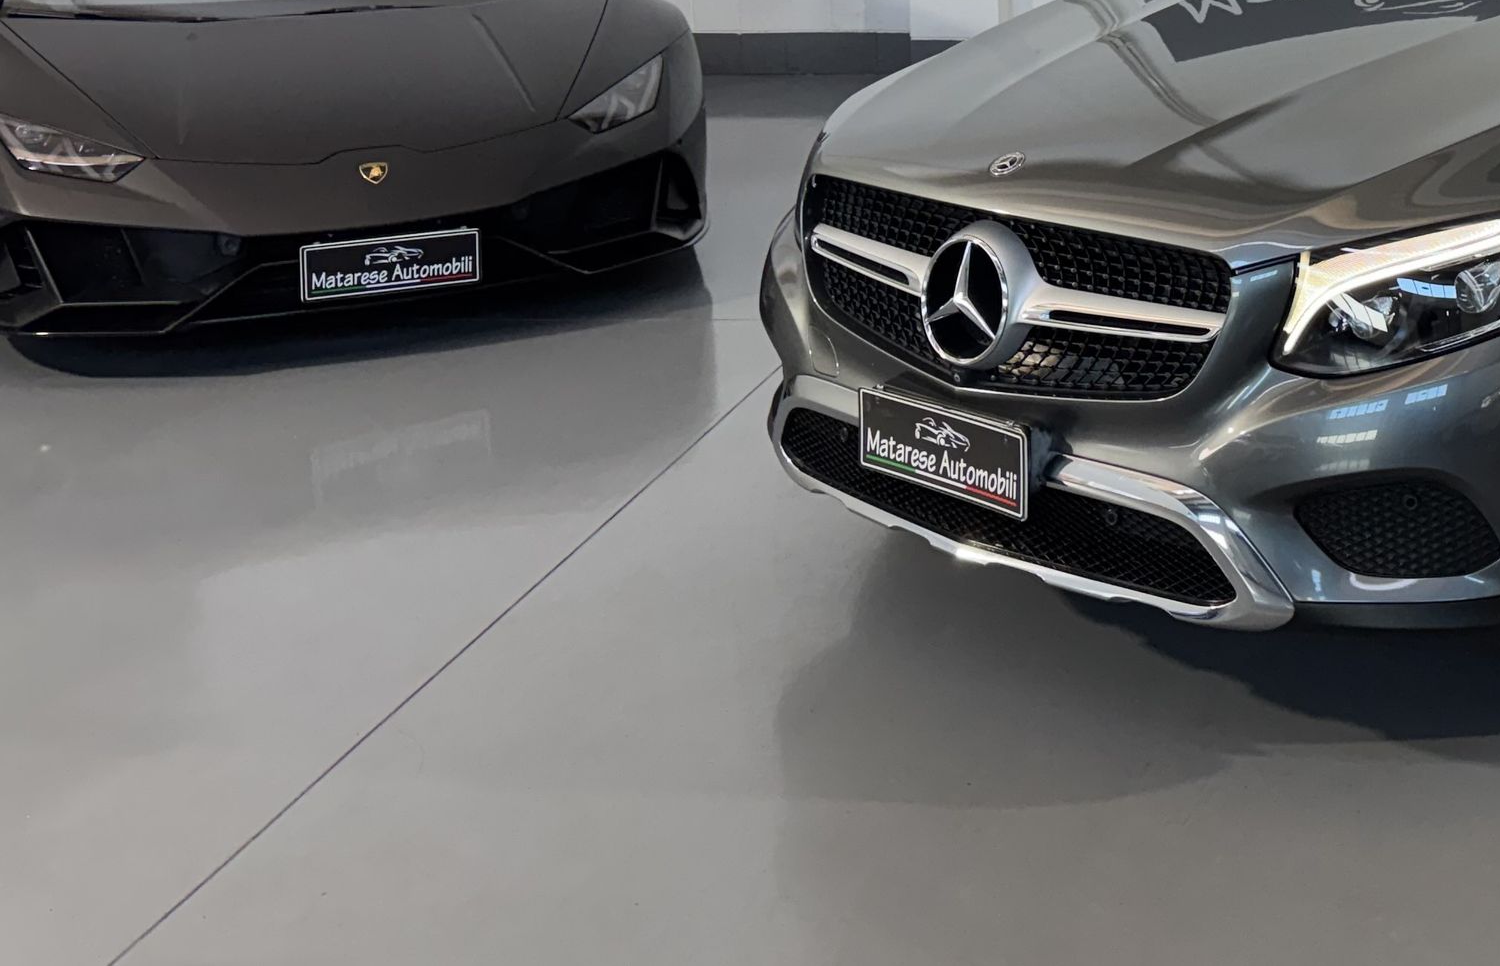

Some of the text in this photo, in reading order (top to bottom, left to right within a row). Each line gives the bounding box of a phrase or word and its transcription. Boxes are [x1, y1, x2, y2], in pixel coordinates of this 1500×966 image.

[311, 255, 472, 290] Matarese Automobili
[866, 427, 1017, 500] Matarese Automobili
